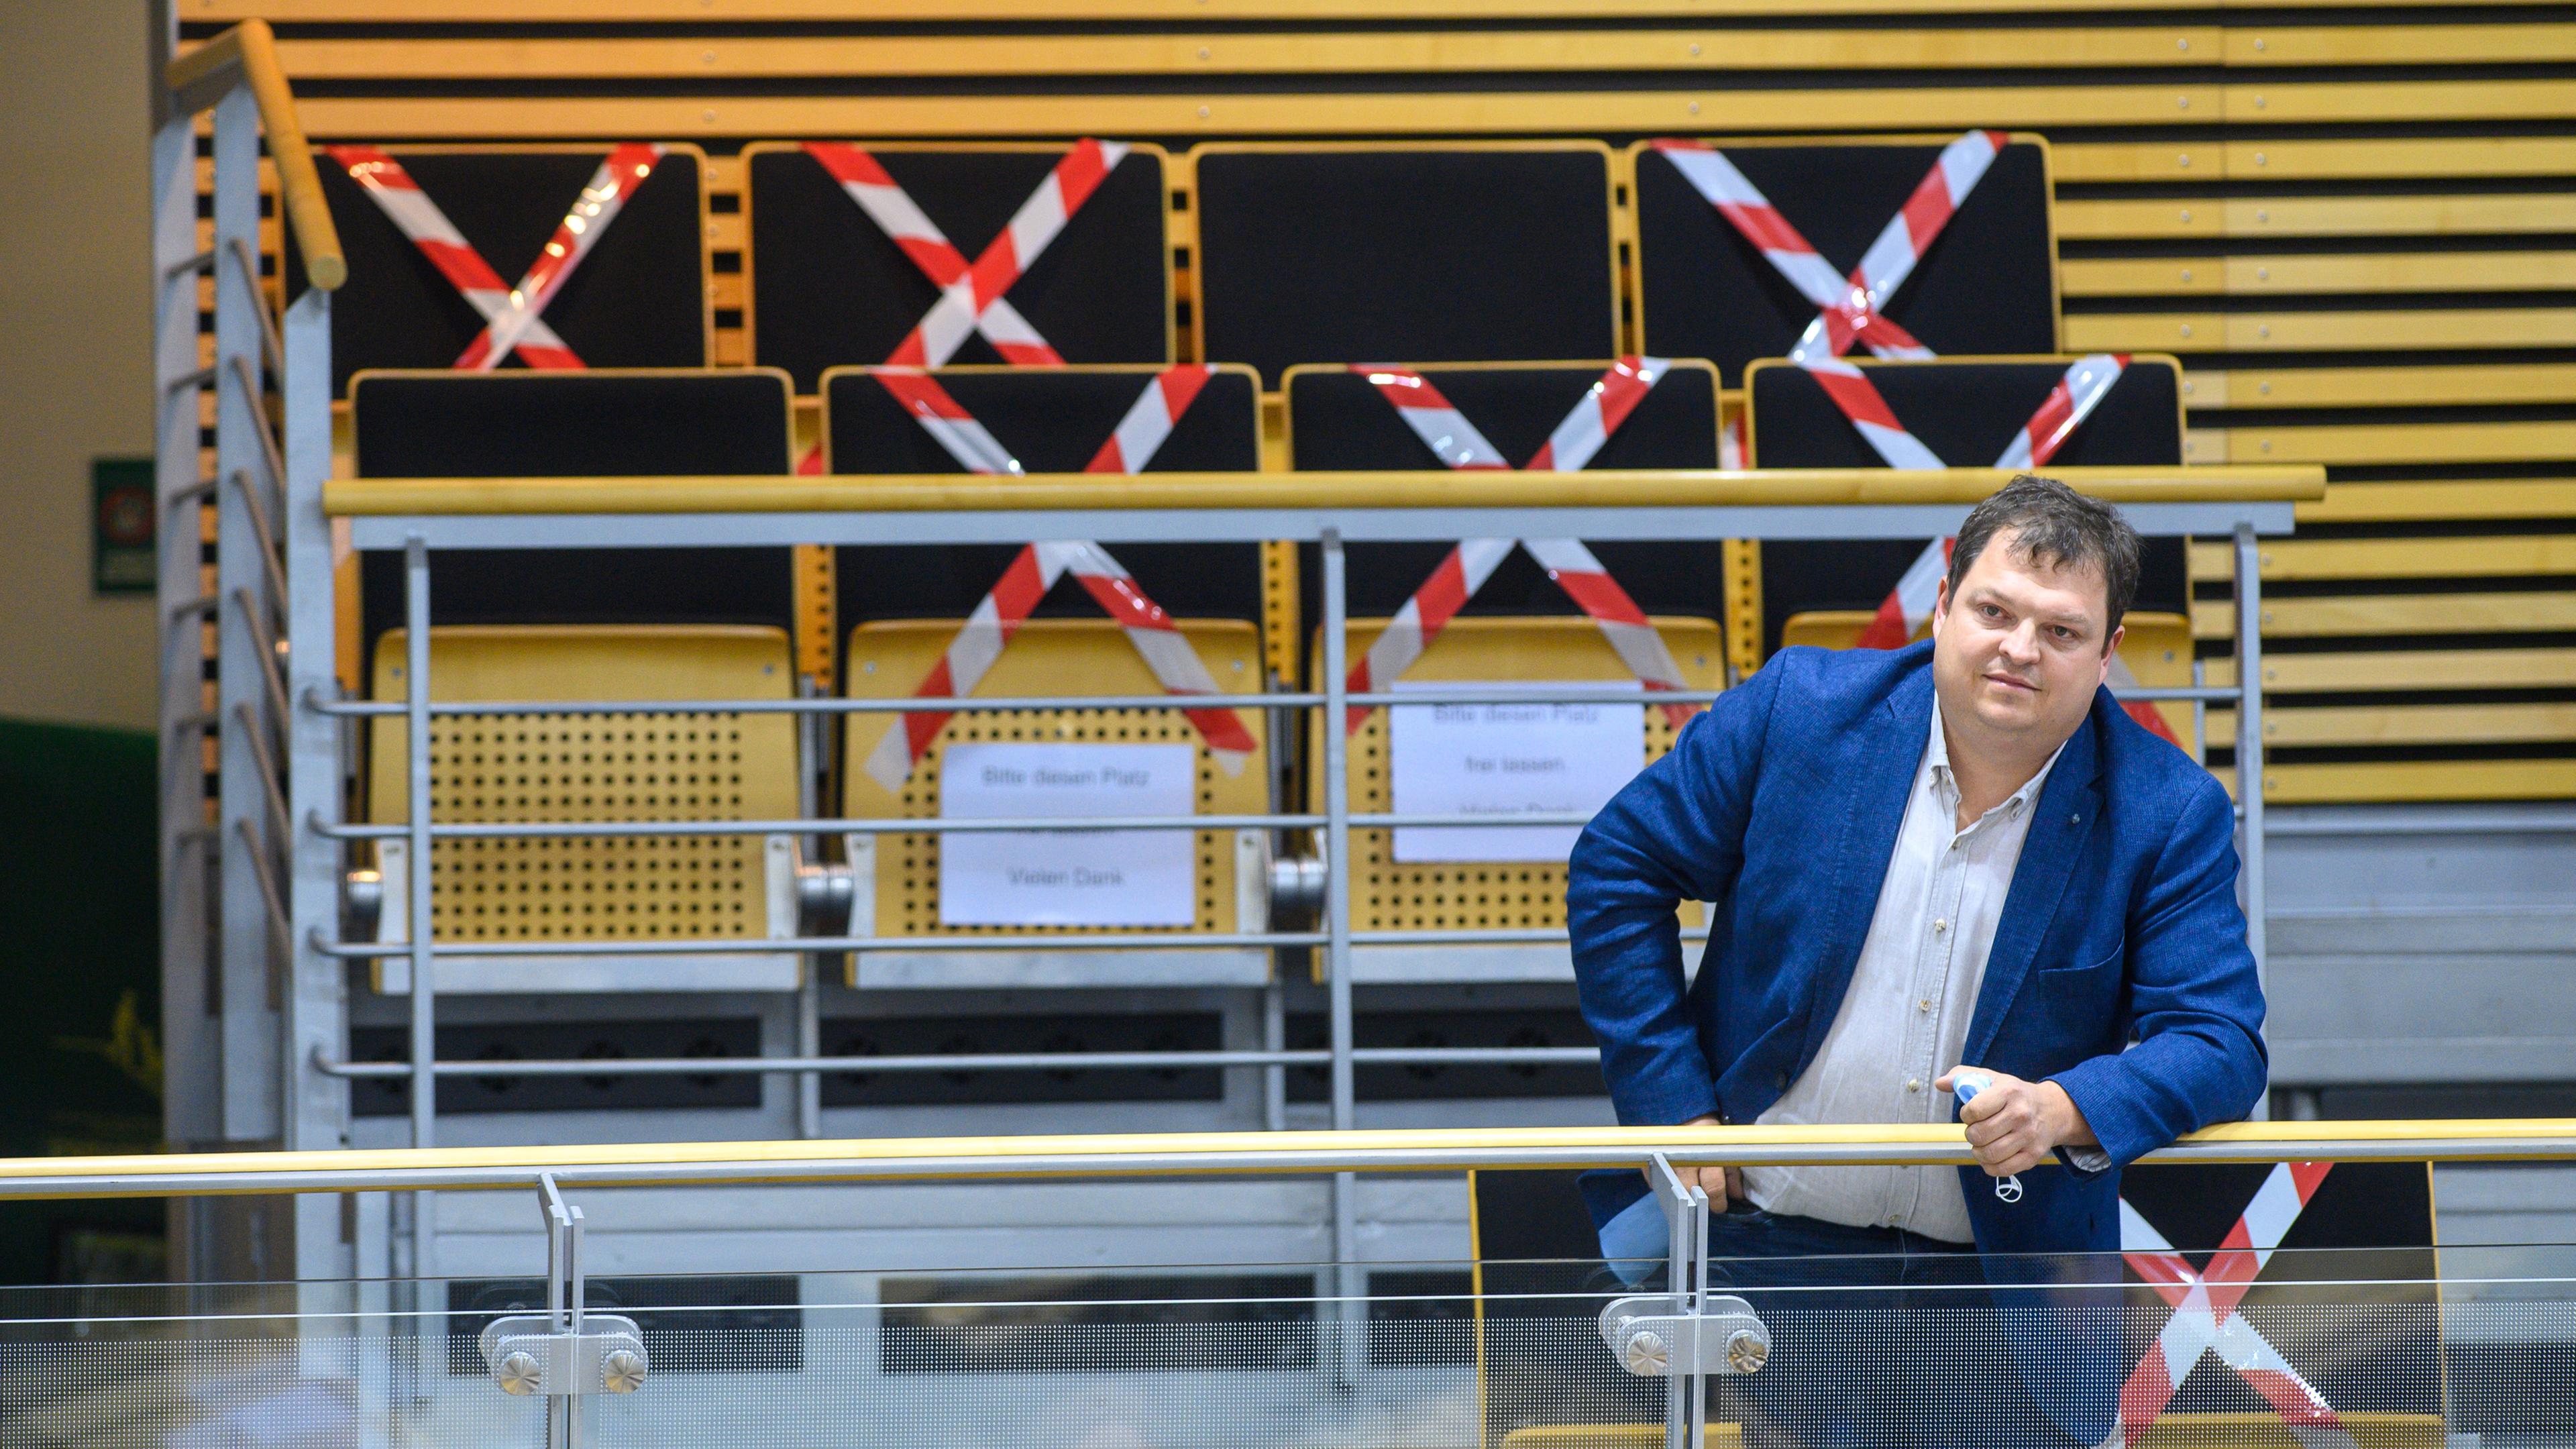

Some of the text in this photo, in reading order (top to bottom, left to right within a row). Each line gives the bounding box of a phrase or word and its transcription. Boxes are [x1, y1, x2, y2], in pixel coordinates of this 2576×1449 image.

[981, 765, 1151, 786] Bitte diesen Platz
